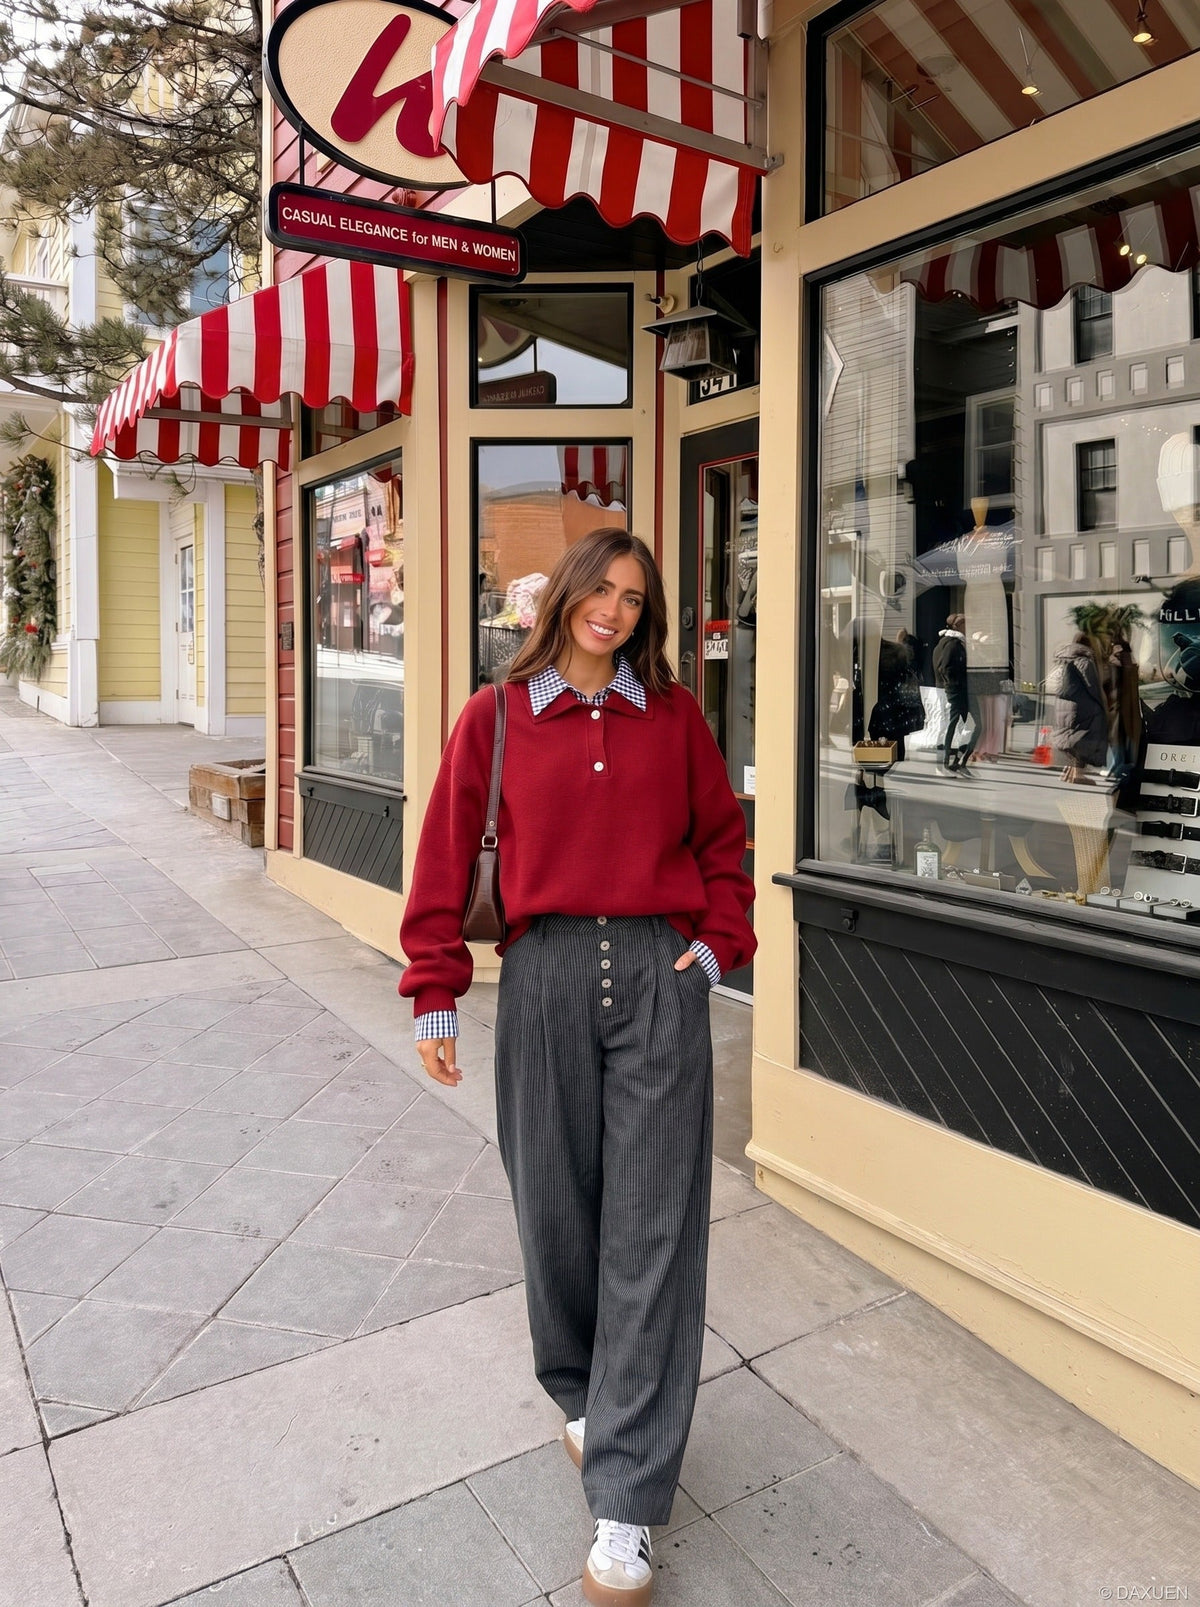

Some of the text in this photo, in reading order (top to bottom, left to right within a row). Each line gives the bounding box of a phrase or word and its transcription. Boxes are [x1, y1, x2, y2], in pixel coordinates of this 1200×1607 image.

[282, 207, 516, 262] CASUAL ELEGANCE for MEN & WOMEN
